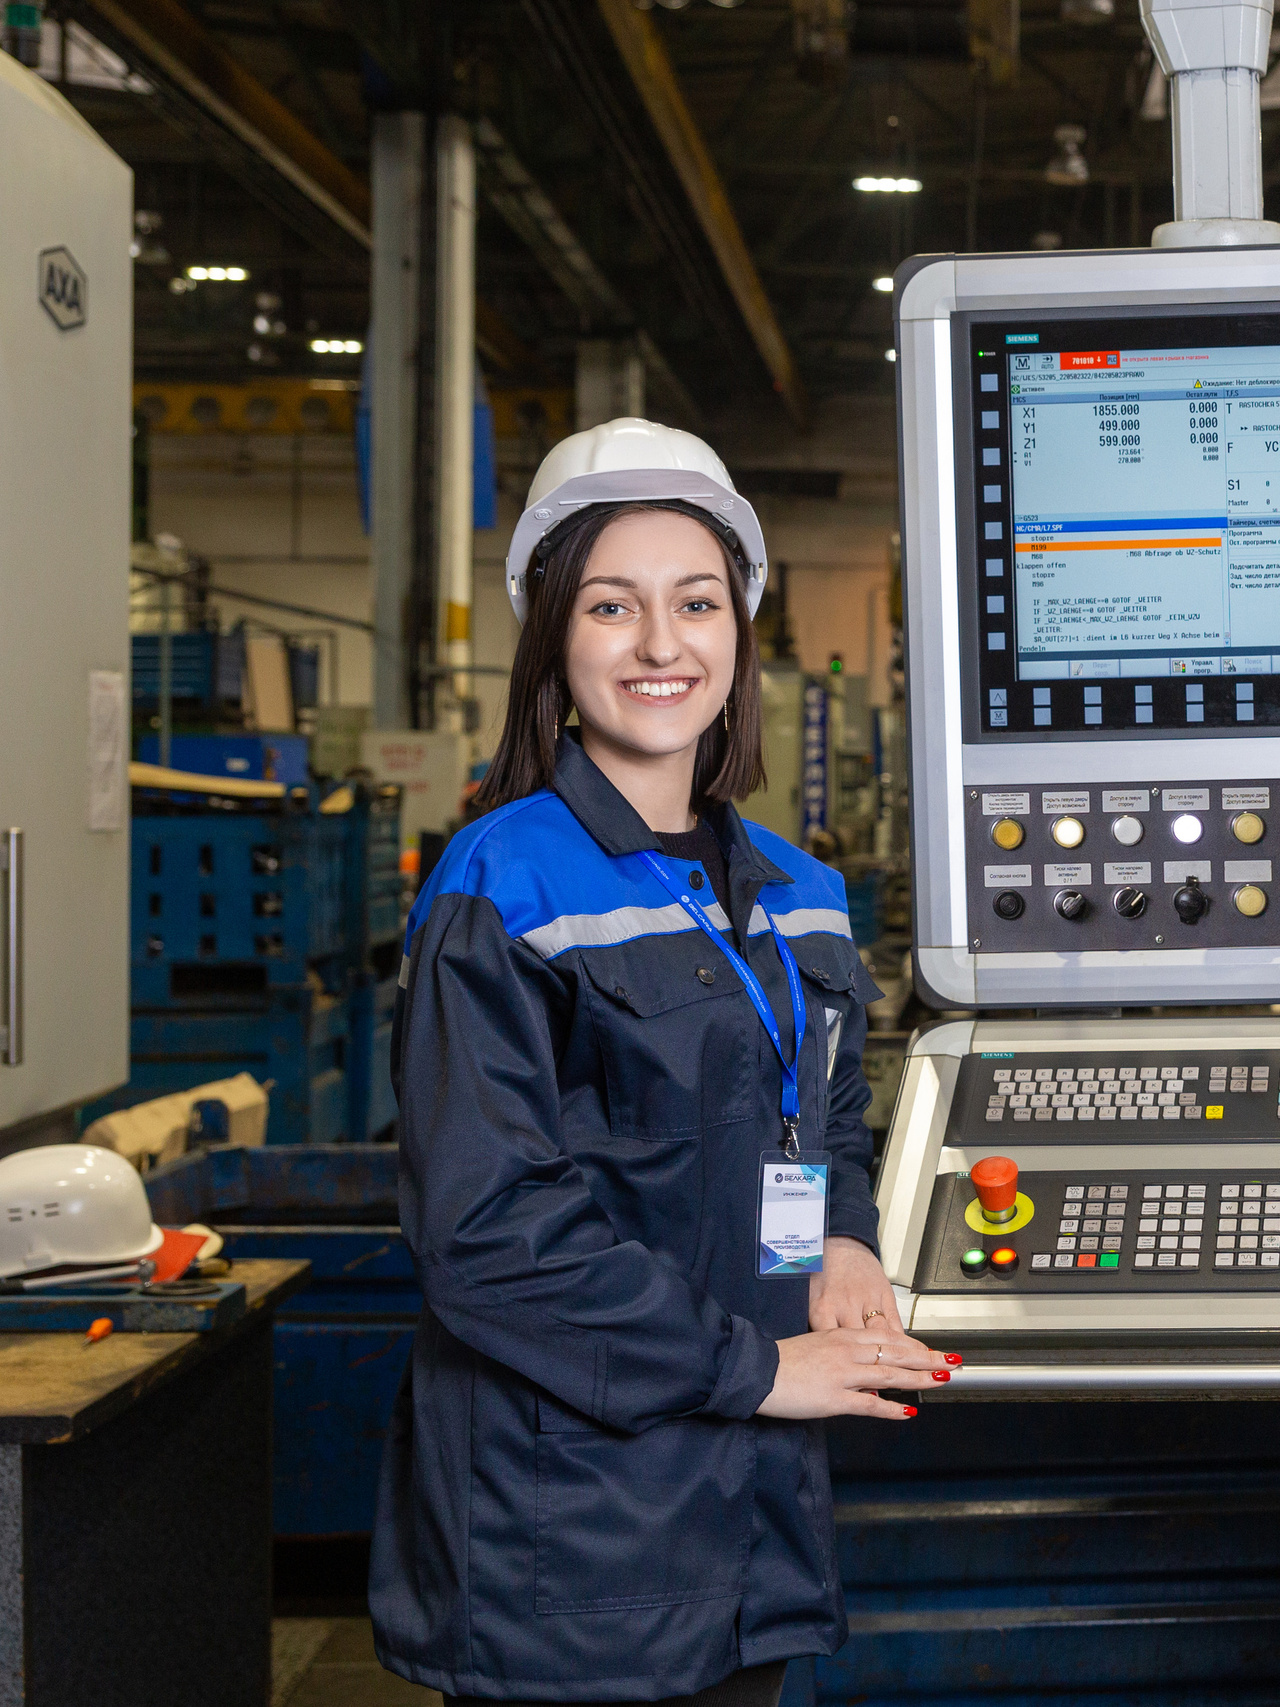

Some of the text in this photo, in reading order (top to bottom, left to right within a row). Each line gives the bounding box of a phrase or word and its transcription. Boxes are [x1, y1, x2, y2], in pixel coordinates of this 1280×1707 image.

[1107, 355, 1117, 364] PLC
[1100, 393, 1124, 401] Позиция
[1023, 402, 1217, 419] X1 1855.000 0.000
[1226, 403, 1232, 414] T
[1239, 401, 1274, 409] RASTOCHKA
[1023, 417, 1218, 434] Y1 499.000 0.000
[1024, 432, 1218, 449] Z1 599.000 0.000
[1227, 442, 1233, 453] F
[1228, 479, 1241, 490] S1
[1228, 529, 1263, 537] Программа
[1031, 534, 1054, 542] stopre
[1145, 550, 1172, 558] Abfrage
[1017, 562, 1044, 570] klappen
[1230, 572, 1243, 580] Зад.
[1158, 632, 1171, 641] Weg
[1191, 659, 1214, 667] Управл.
